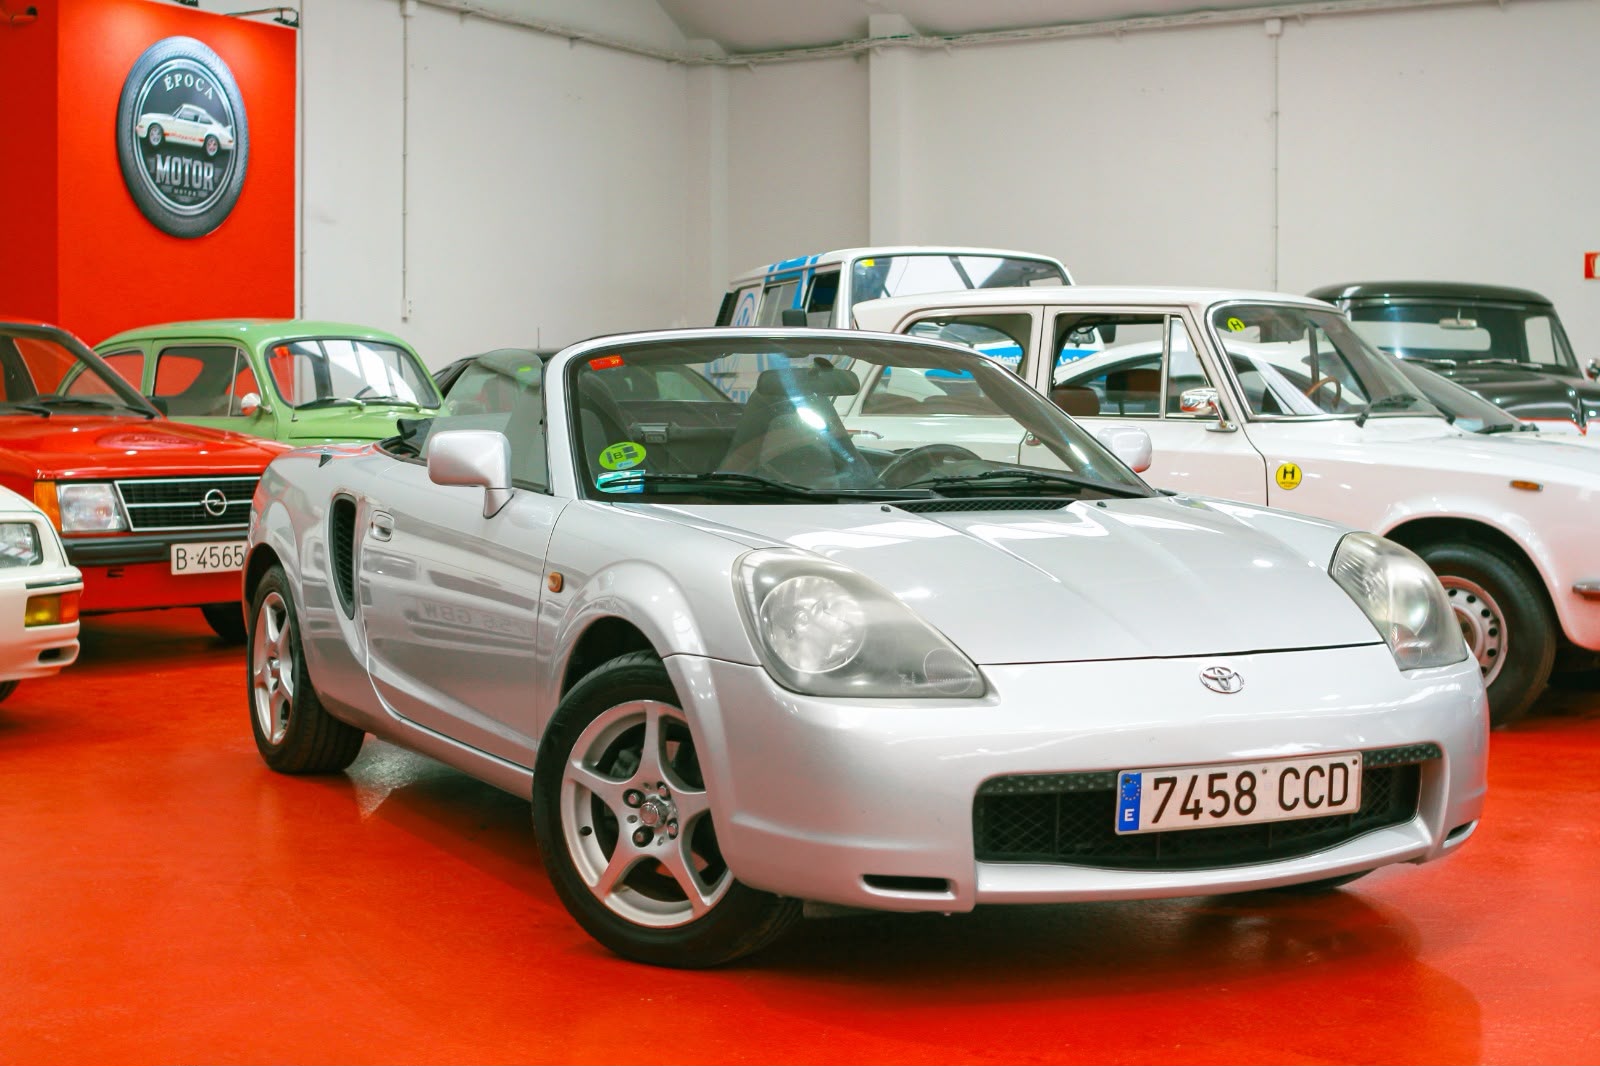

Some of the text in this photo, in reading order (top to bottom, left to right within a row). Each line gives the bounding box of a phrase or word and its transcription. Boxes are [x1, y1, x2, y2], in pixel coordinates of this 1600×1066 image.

[163, 73, 214, 100] ÉPOCA
[155, 153, 215, 191] MOTOR
[1230, 320, 1242, 330] H
[1283, 466, 1295, 480] H
[1151, 762, 1349, 824] 7458 CCD
[1124, 808, 1135, 822] E
